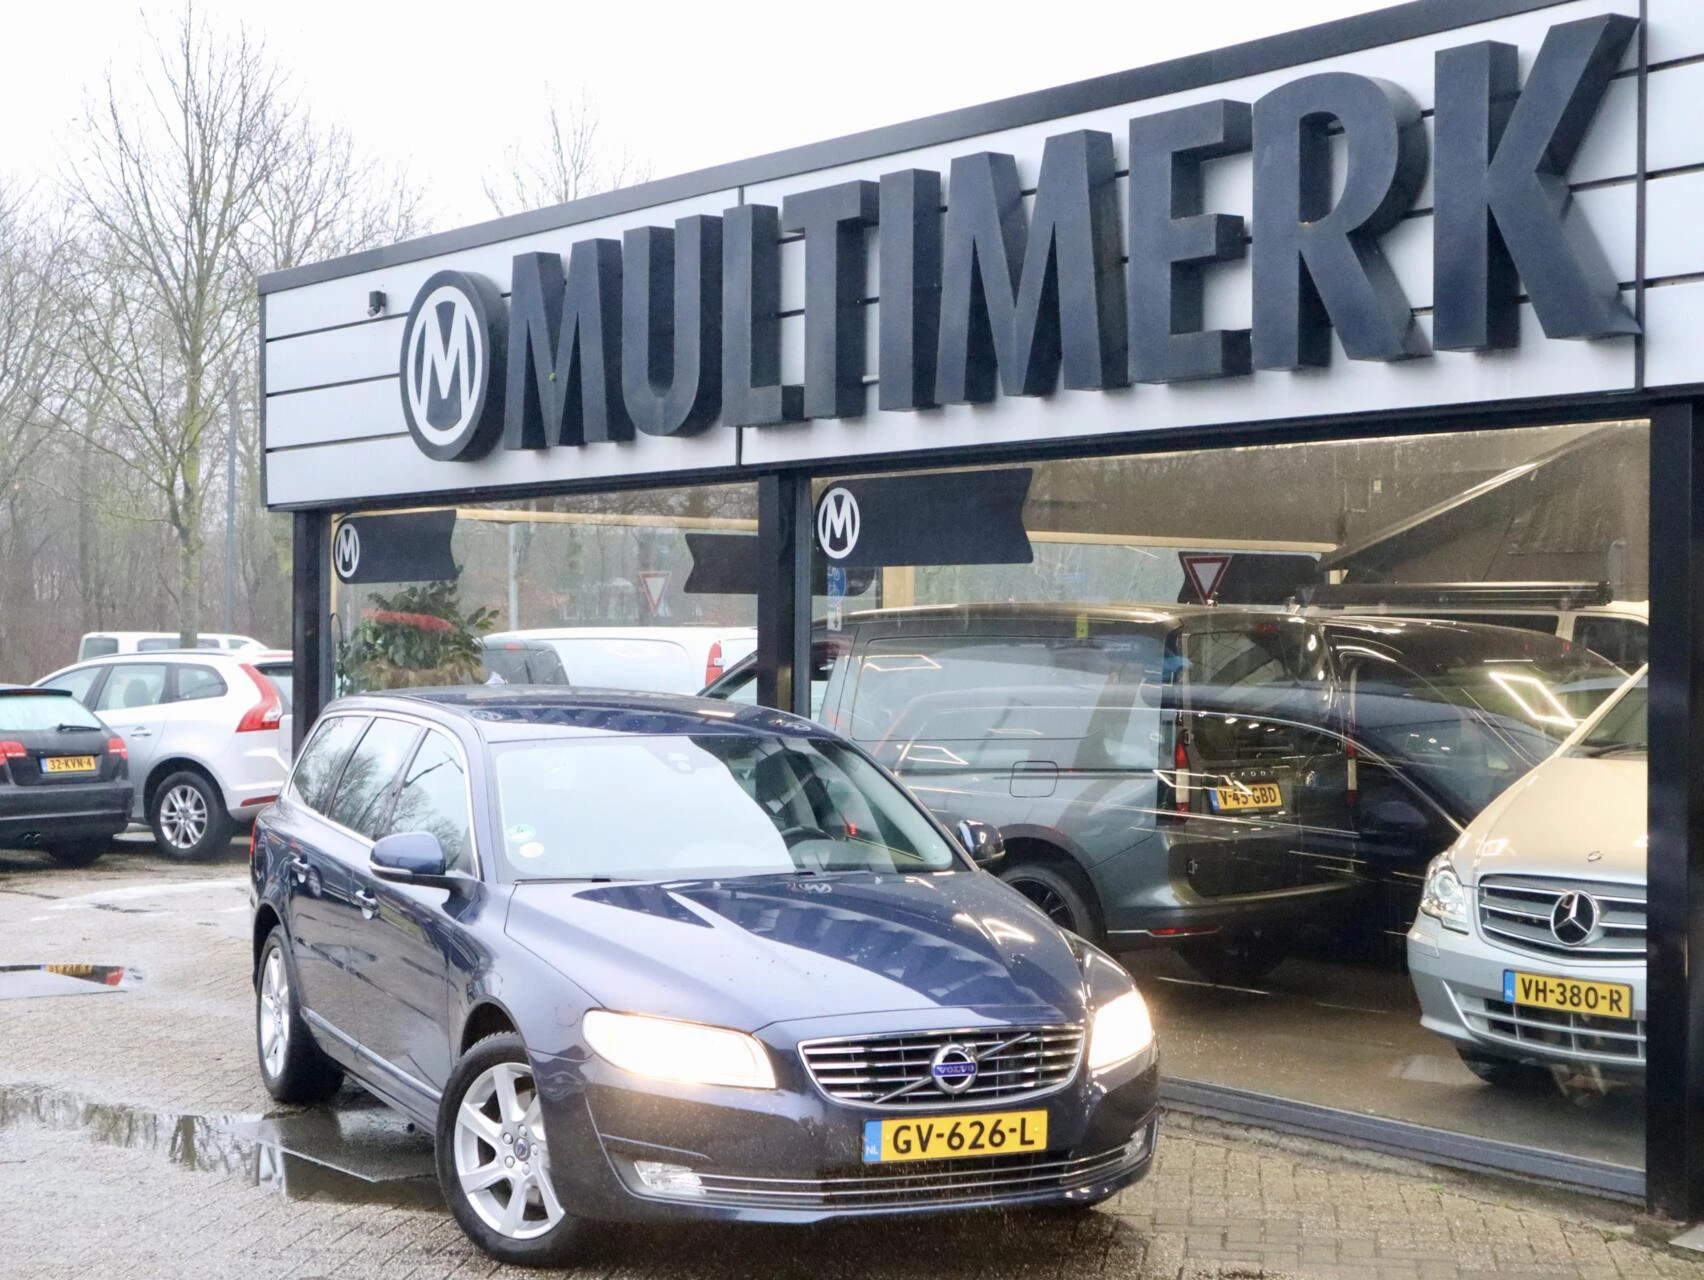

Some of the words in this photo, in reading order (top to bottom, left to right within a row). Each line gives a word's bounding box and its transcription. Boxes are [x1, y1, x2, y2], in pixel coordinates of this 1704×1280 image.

[505, 14, 1641, 451] MULTIMERK
[412, 288, 478, 443] M
[820, 489, 858, 557] M
[336, 524, 359, 577] M
[49, 758, 92, 769] 32-KVN-4
[1219, 786, 1277, 806] V-45-GBD
[1521, 977, 1622, 1012] VH-380-R
[936, 1065, 975, 1074] VOLVO
[892, 1117, 1035, 1154] GV-626-L
